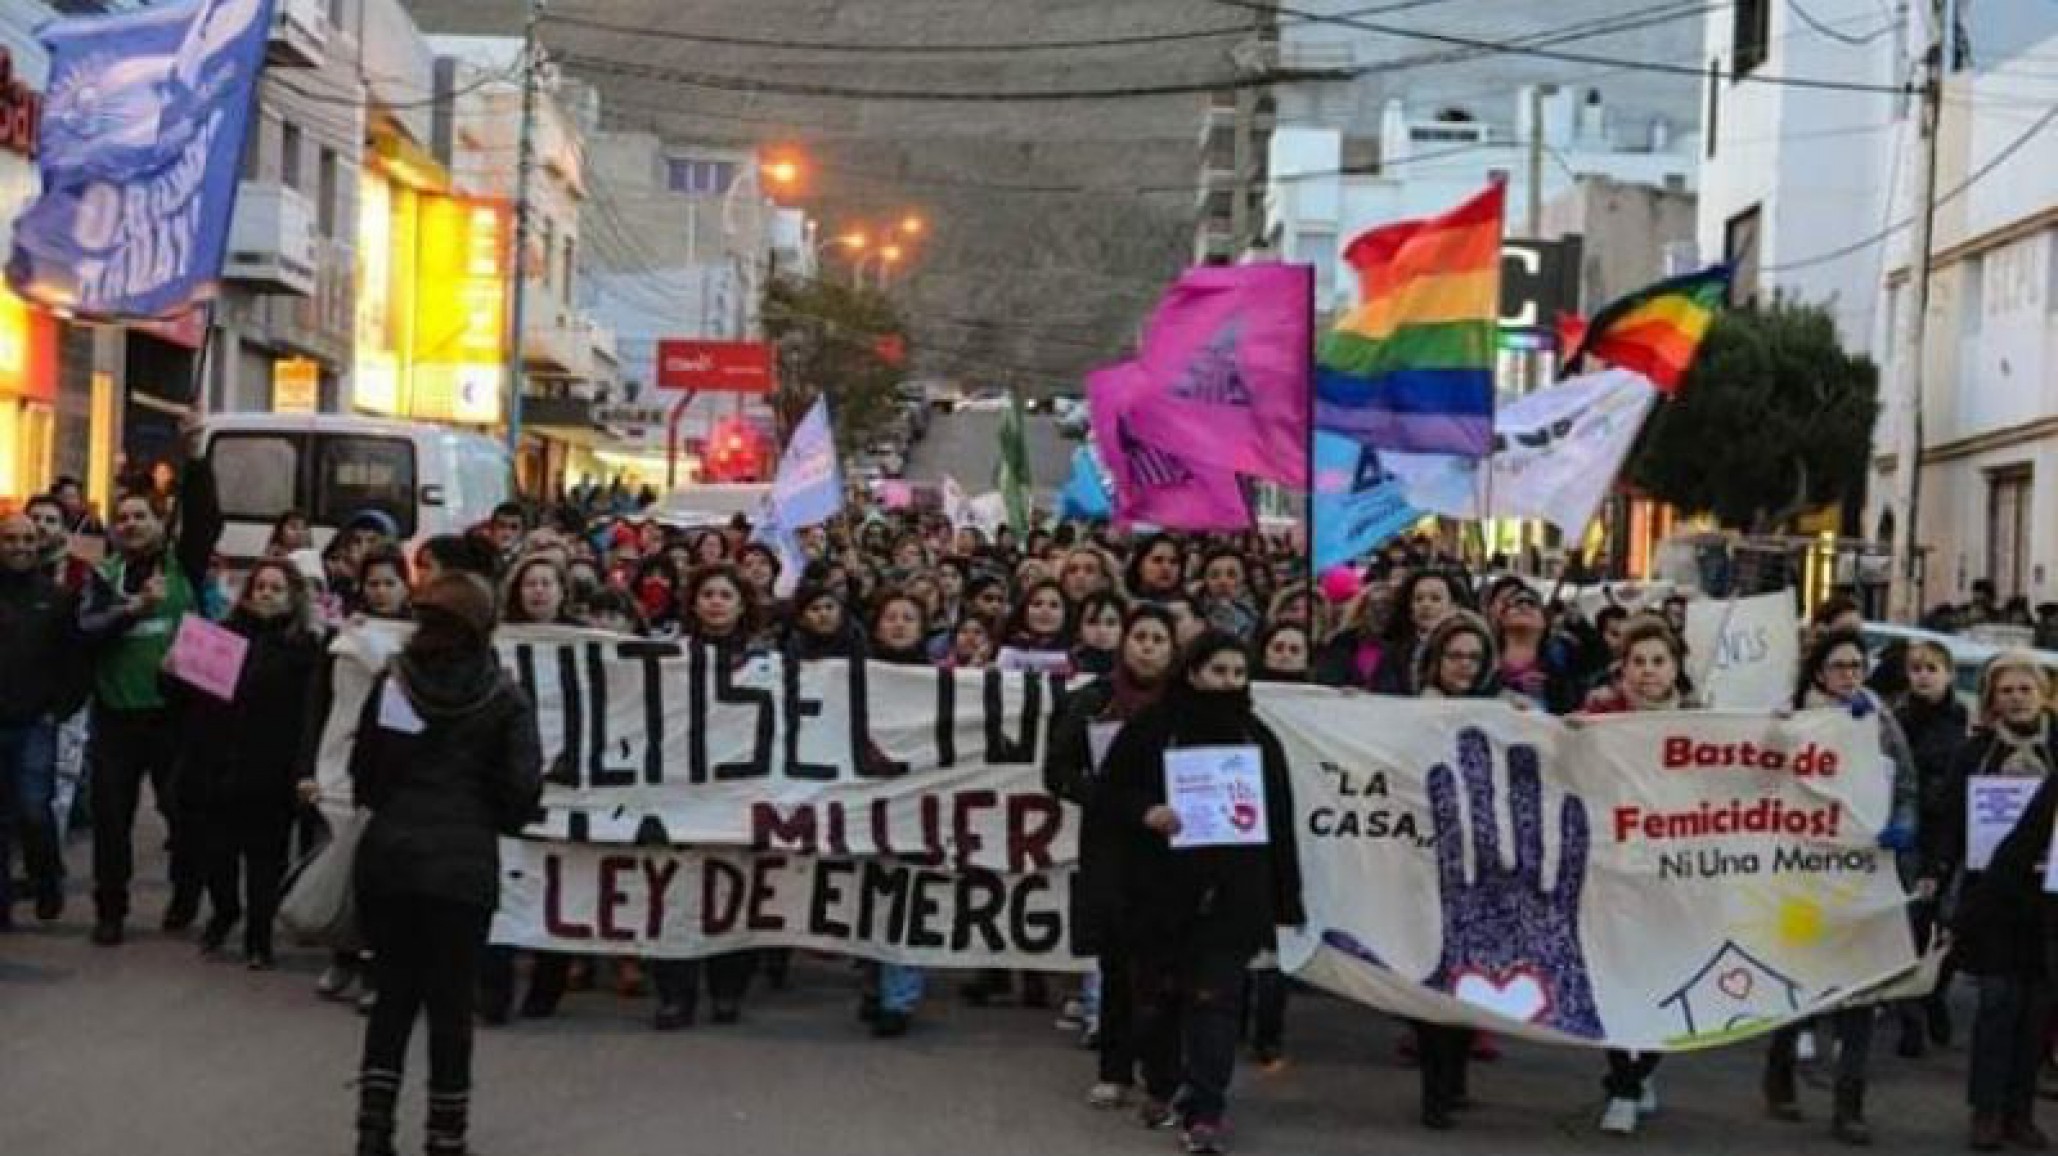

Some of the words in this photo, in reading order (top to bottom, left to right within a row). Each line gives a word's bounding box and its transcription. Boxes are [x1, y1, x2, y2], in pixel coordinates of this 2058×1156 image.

[1662, 737, 1788, 770] Basta
[1792, 742, 1837, 775] de
[1613, 797, 1842, 842] Femicidios!
[1657, 851, 1694, 879] Ni
[1698, 847, 1760, 878] Una
[543, 855, 680, 941] LEY
[702, 856, 788, 937] DE
[808, 861, 1085, 954] EMERG
